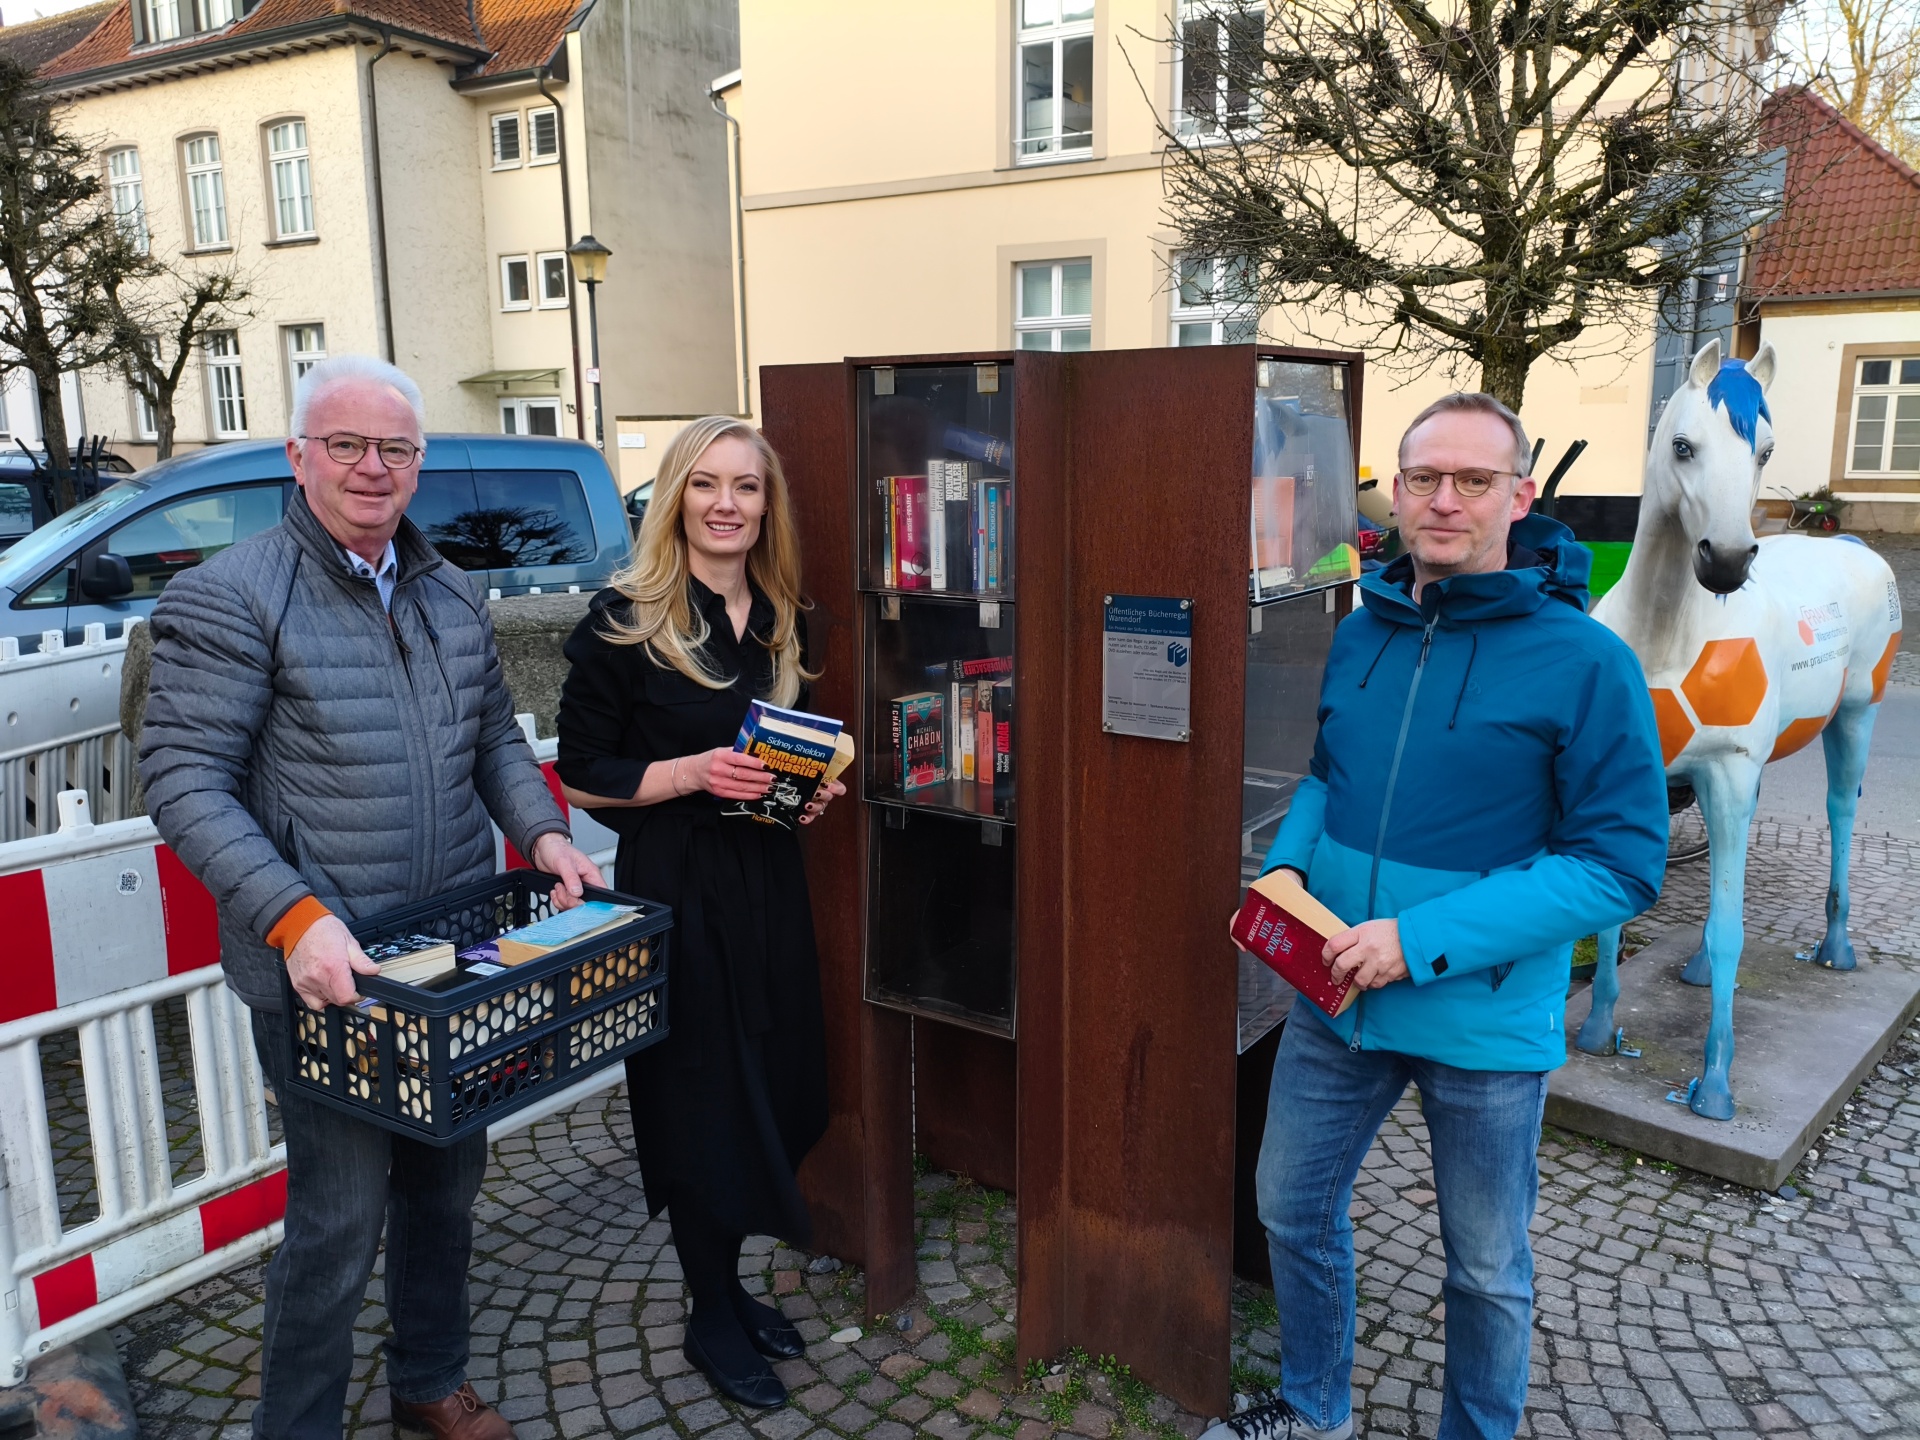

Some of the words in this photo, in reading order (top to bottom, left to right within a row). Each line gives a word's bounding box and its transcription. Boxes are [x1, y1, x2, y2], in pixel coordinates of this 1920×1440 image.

[945, 463, 953, 500] NORMAN
[953, 463, 961, 500] MAILER
[1108, 607, 1146, 617] Öffentliches
[1148, 610, 1188, 620] Bücherregal
[1108, 615, 1142, 623] Warendorf
[908, 730, 940, 749] CHABON
[916, 726, 933, 734] MICHAEL
[997, 721, 1009, 753] AZRAEL
[754, 742, 828, 773] Diamanten
[766, 736, 794, 750] Sidney
[794, 744, 826, 758] Sheldon
[751, 814, 775, 825] Roman
[1247, 920, 1260, 942] REBECCA
[1258, 920, 1274, 940] WER
[1264, 918, 1288, 956] DORNEN
[1280, 936, 1294, 955] SÄT
